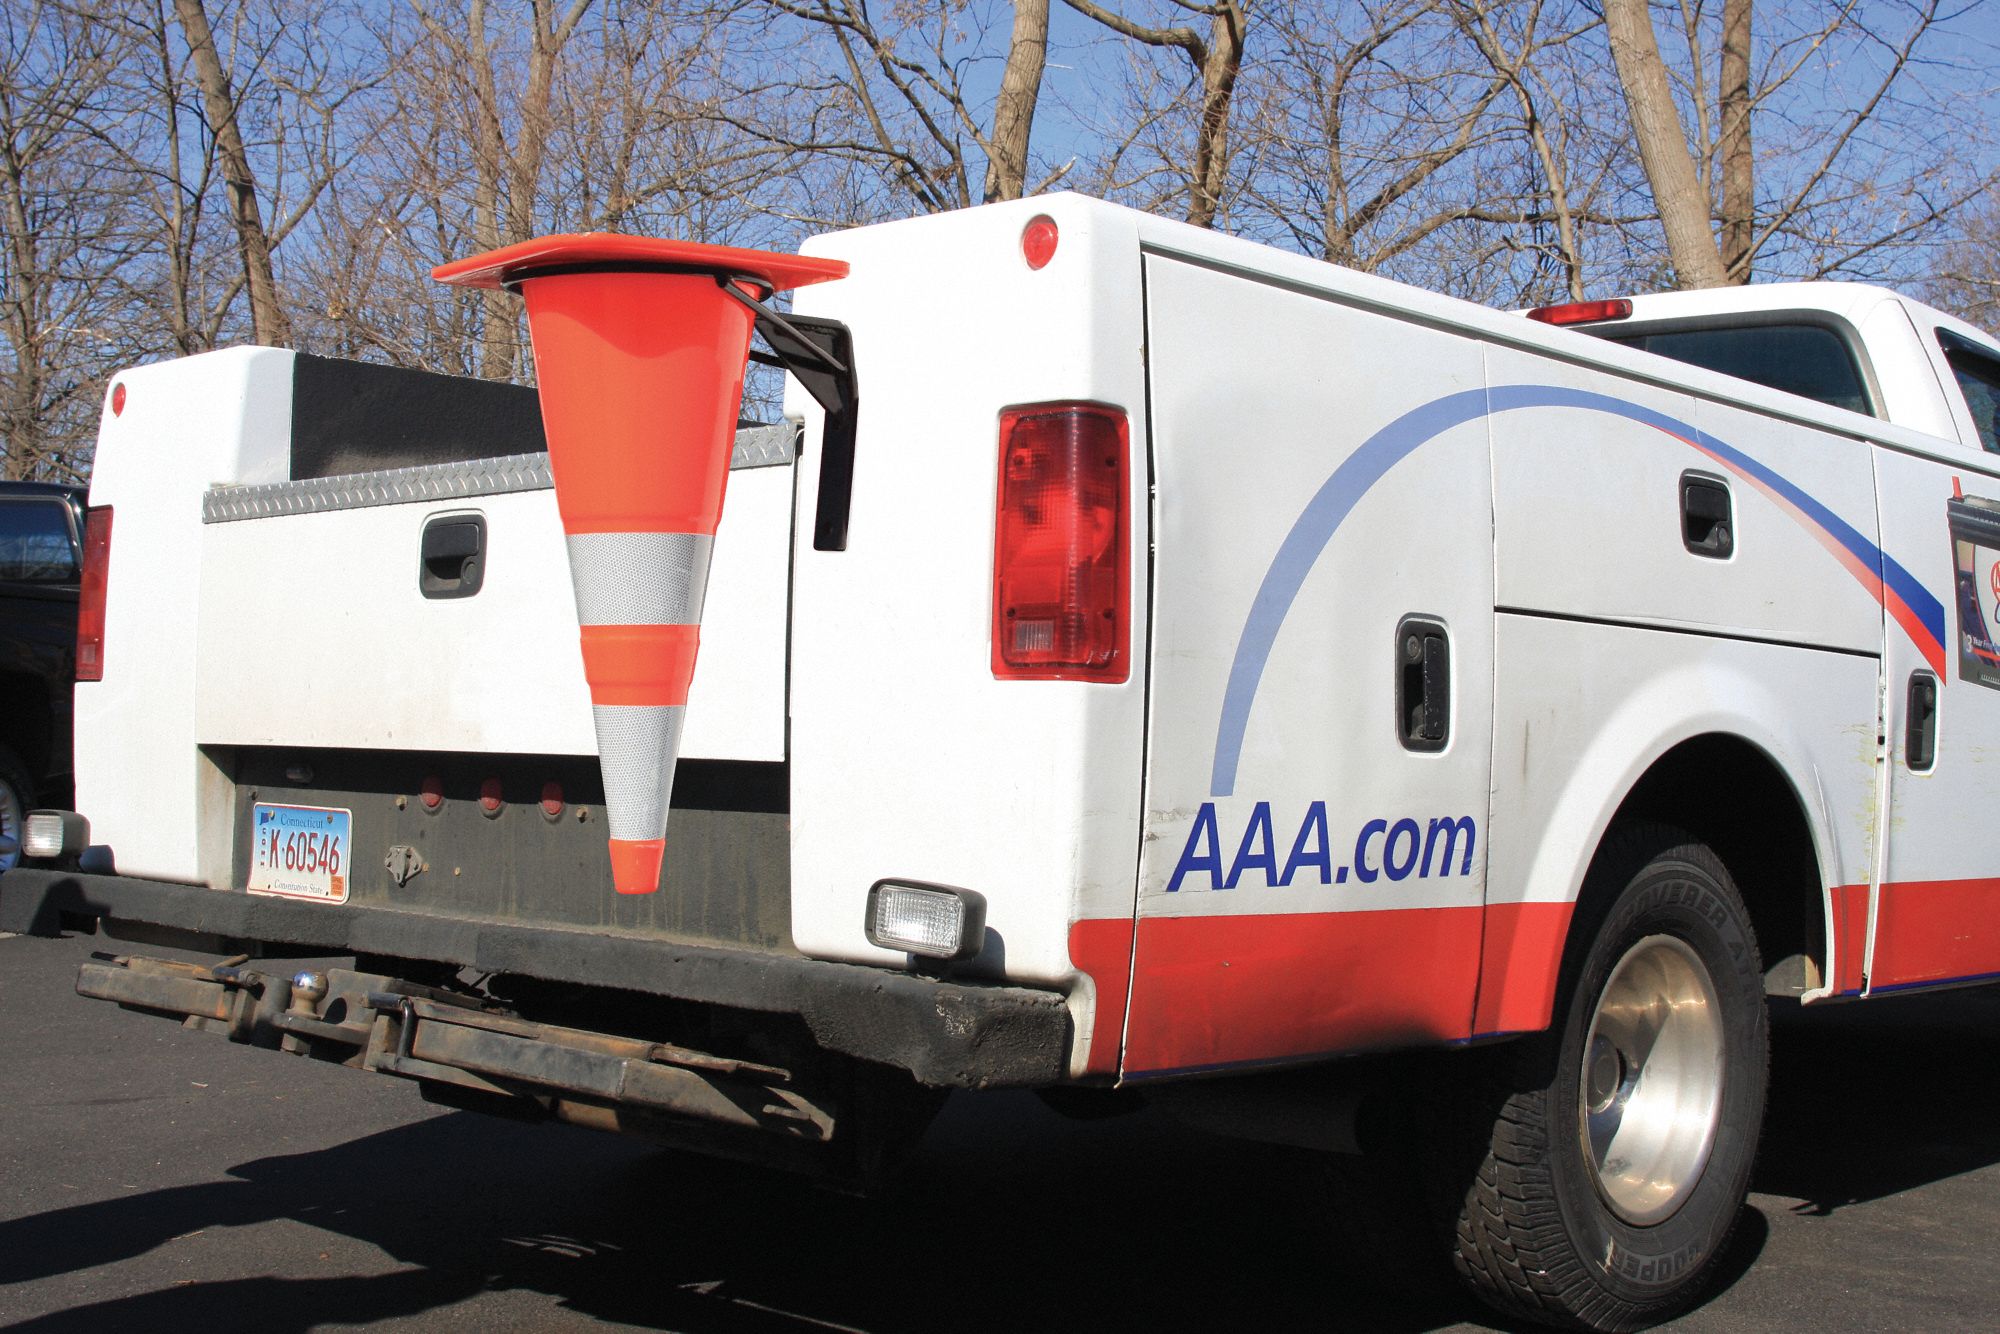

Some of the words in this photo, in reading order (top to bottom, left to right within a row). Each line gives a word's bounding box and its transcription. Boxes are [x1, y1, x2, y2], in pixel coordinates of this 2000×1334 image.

[1966, 634, 1973, 653] 3
[281, 813, 324, 829] Connecticut
[1166, 801, 1476, 892] AAA.com
